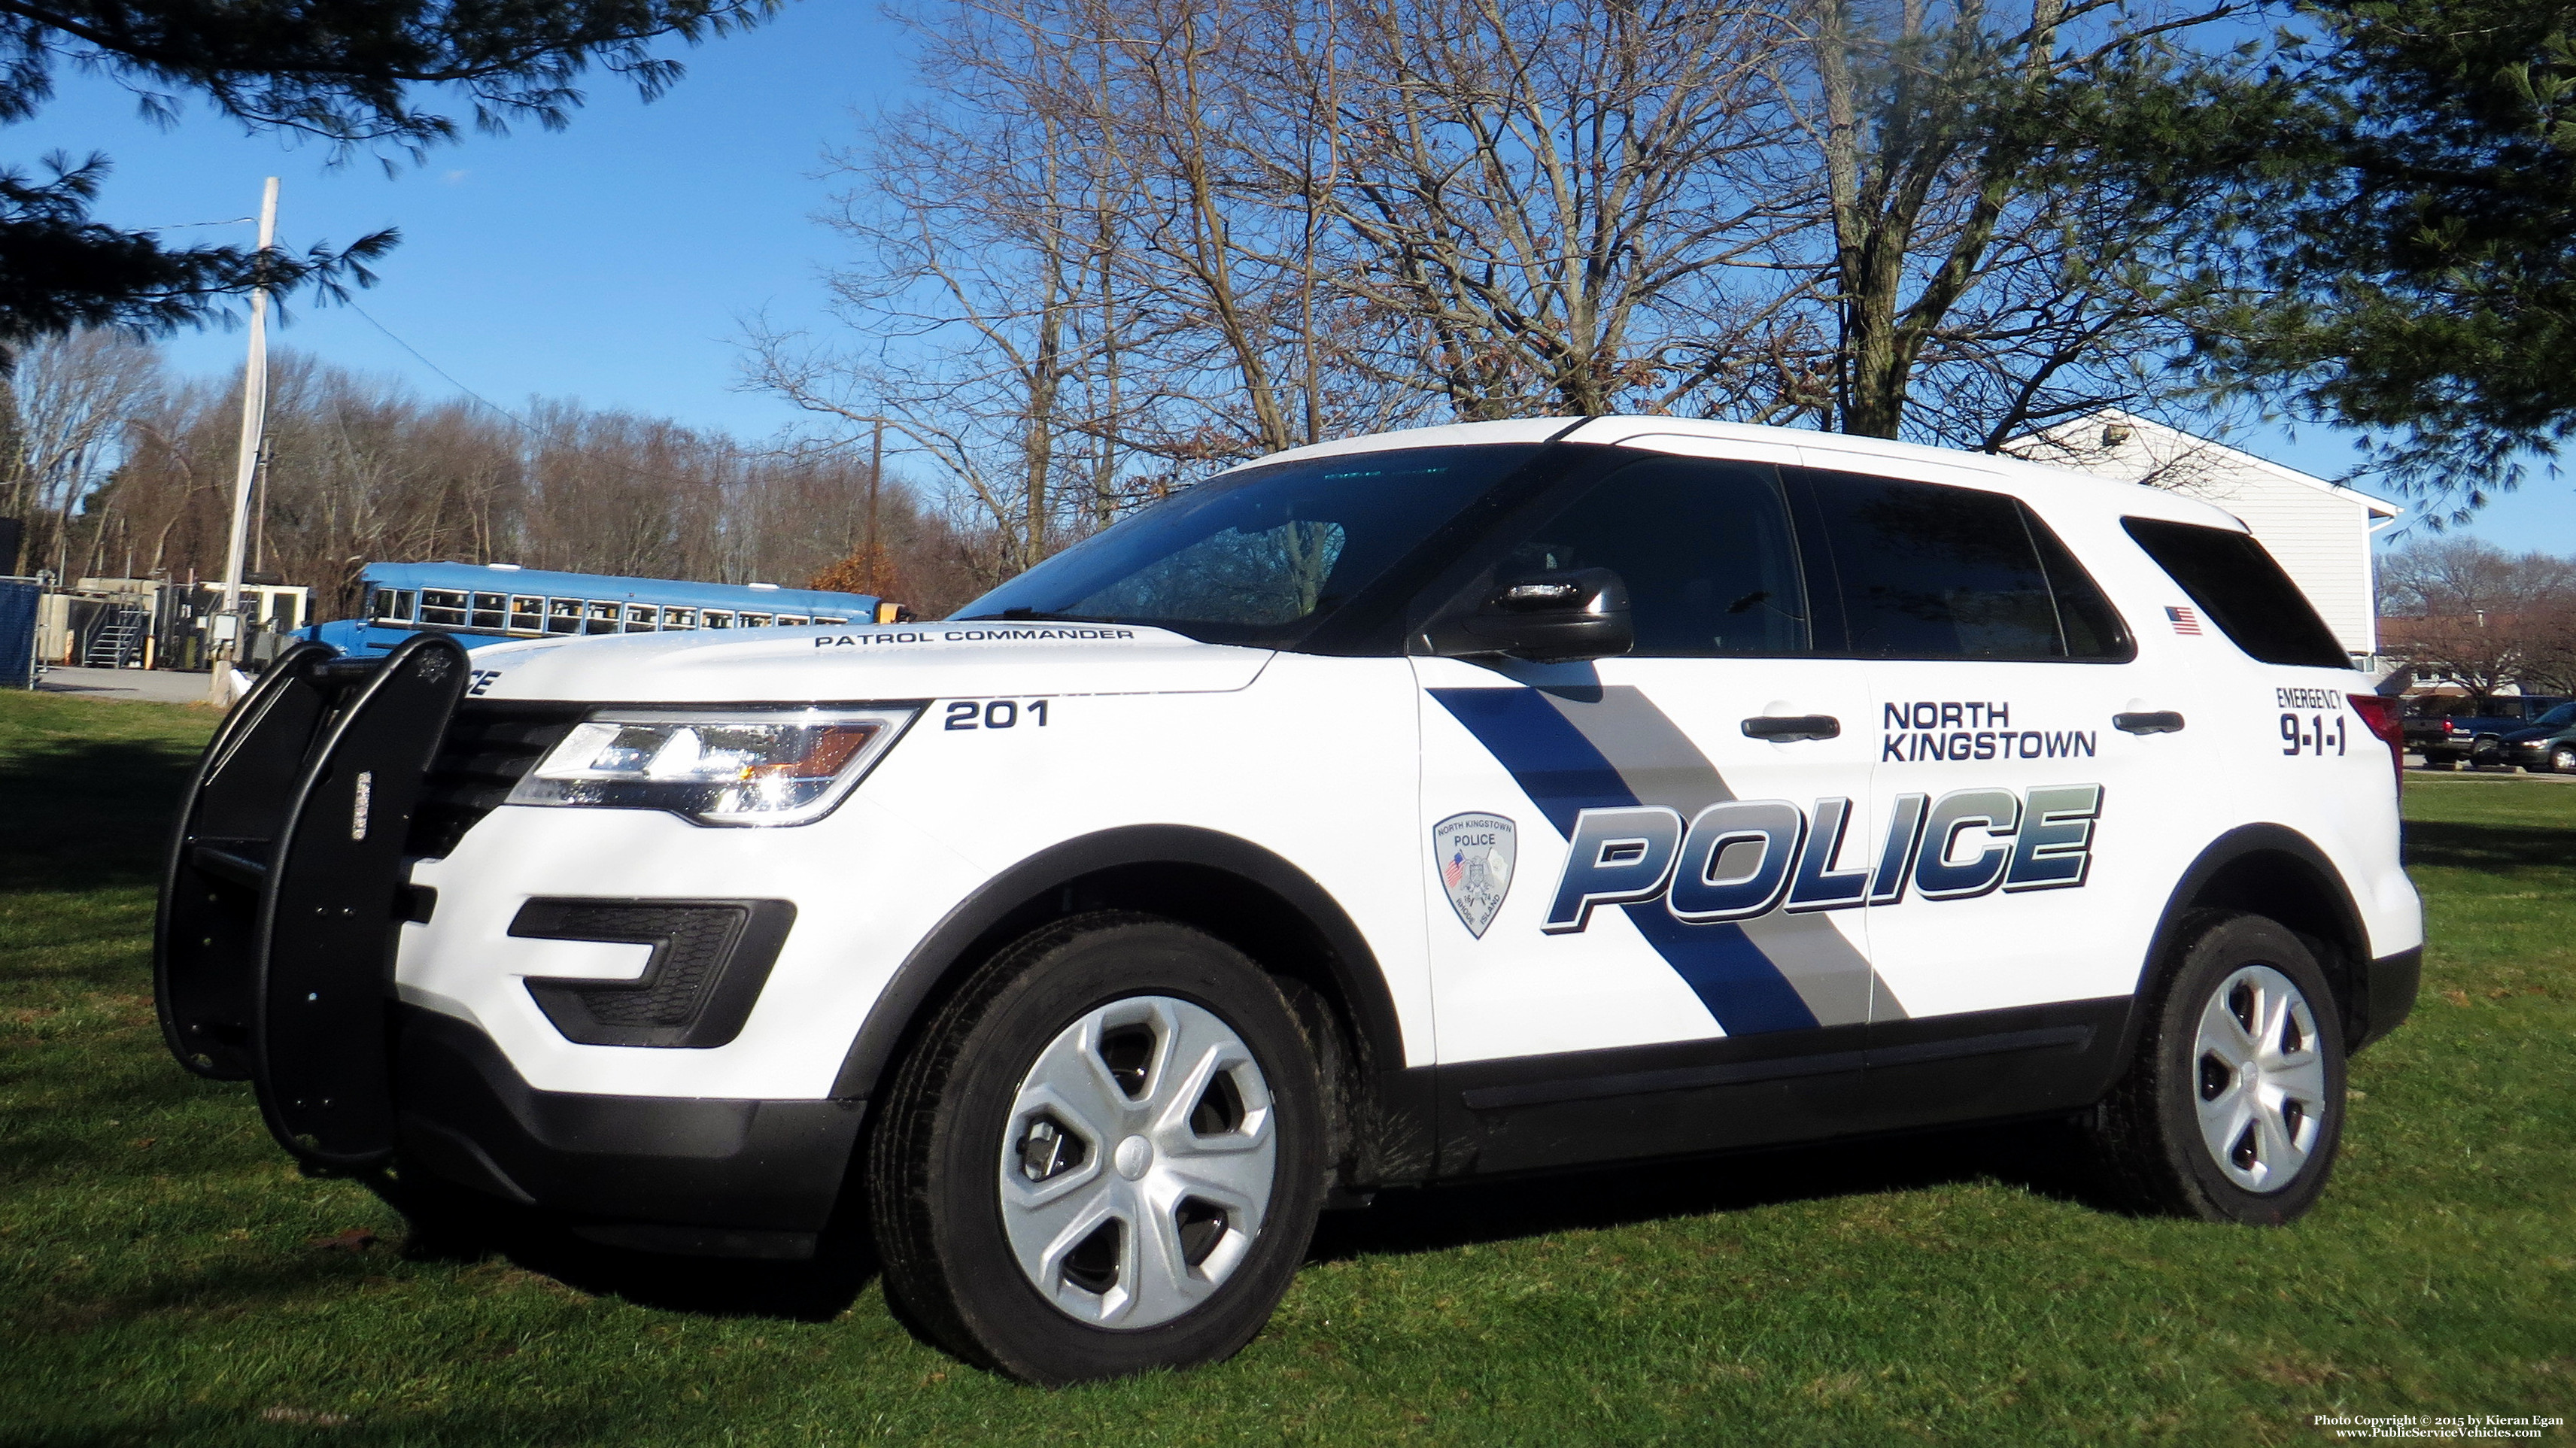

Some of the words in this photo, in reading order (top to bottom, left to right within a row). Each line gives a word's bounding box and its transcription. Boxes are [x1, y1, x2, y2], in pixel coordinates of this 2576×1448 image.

[814, 632, 934, 648] PATROL
[945, 630, 1135, 642] COMMANDER
[2276, 687, 2342, 709] EMERGENCY
[944, 699, 1049, 731] 201
[1884, 701, 2009, 730] NORTH
[1882, 730, 2097, 762] KINGSTOWN
[2280, 713, 2346, 756] 9-1-1
[1438, 821, 1464, 836] NORTH
[1466, 819, 1512, 833] KINGSTOWN
[1454, 833, 1496, 847] POLICE
[1539, 782, 2106, 936] POLICE
[1480, 894, 1500, 925] ISLAND
